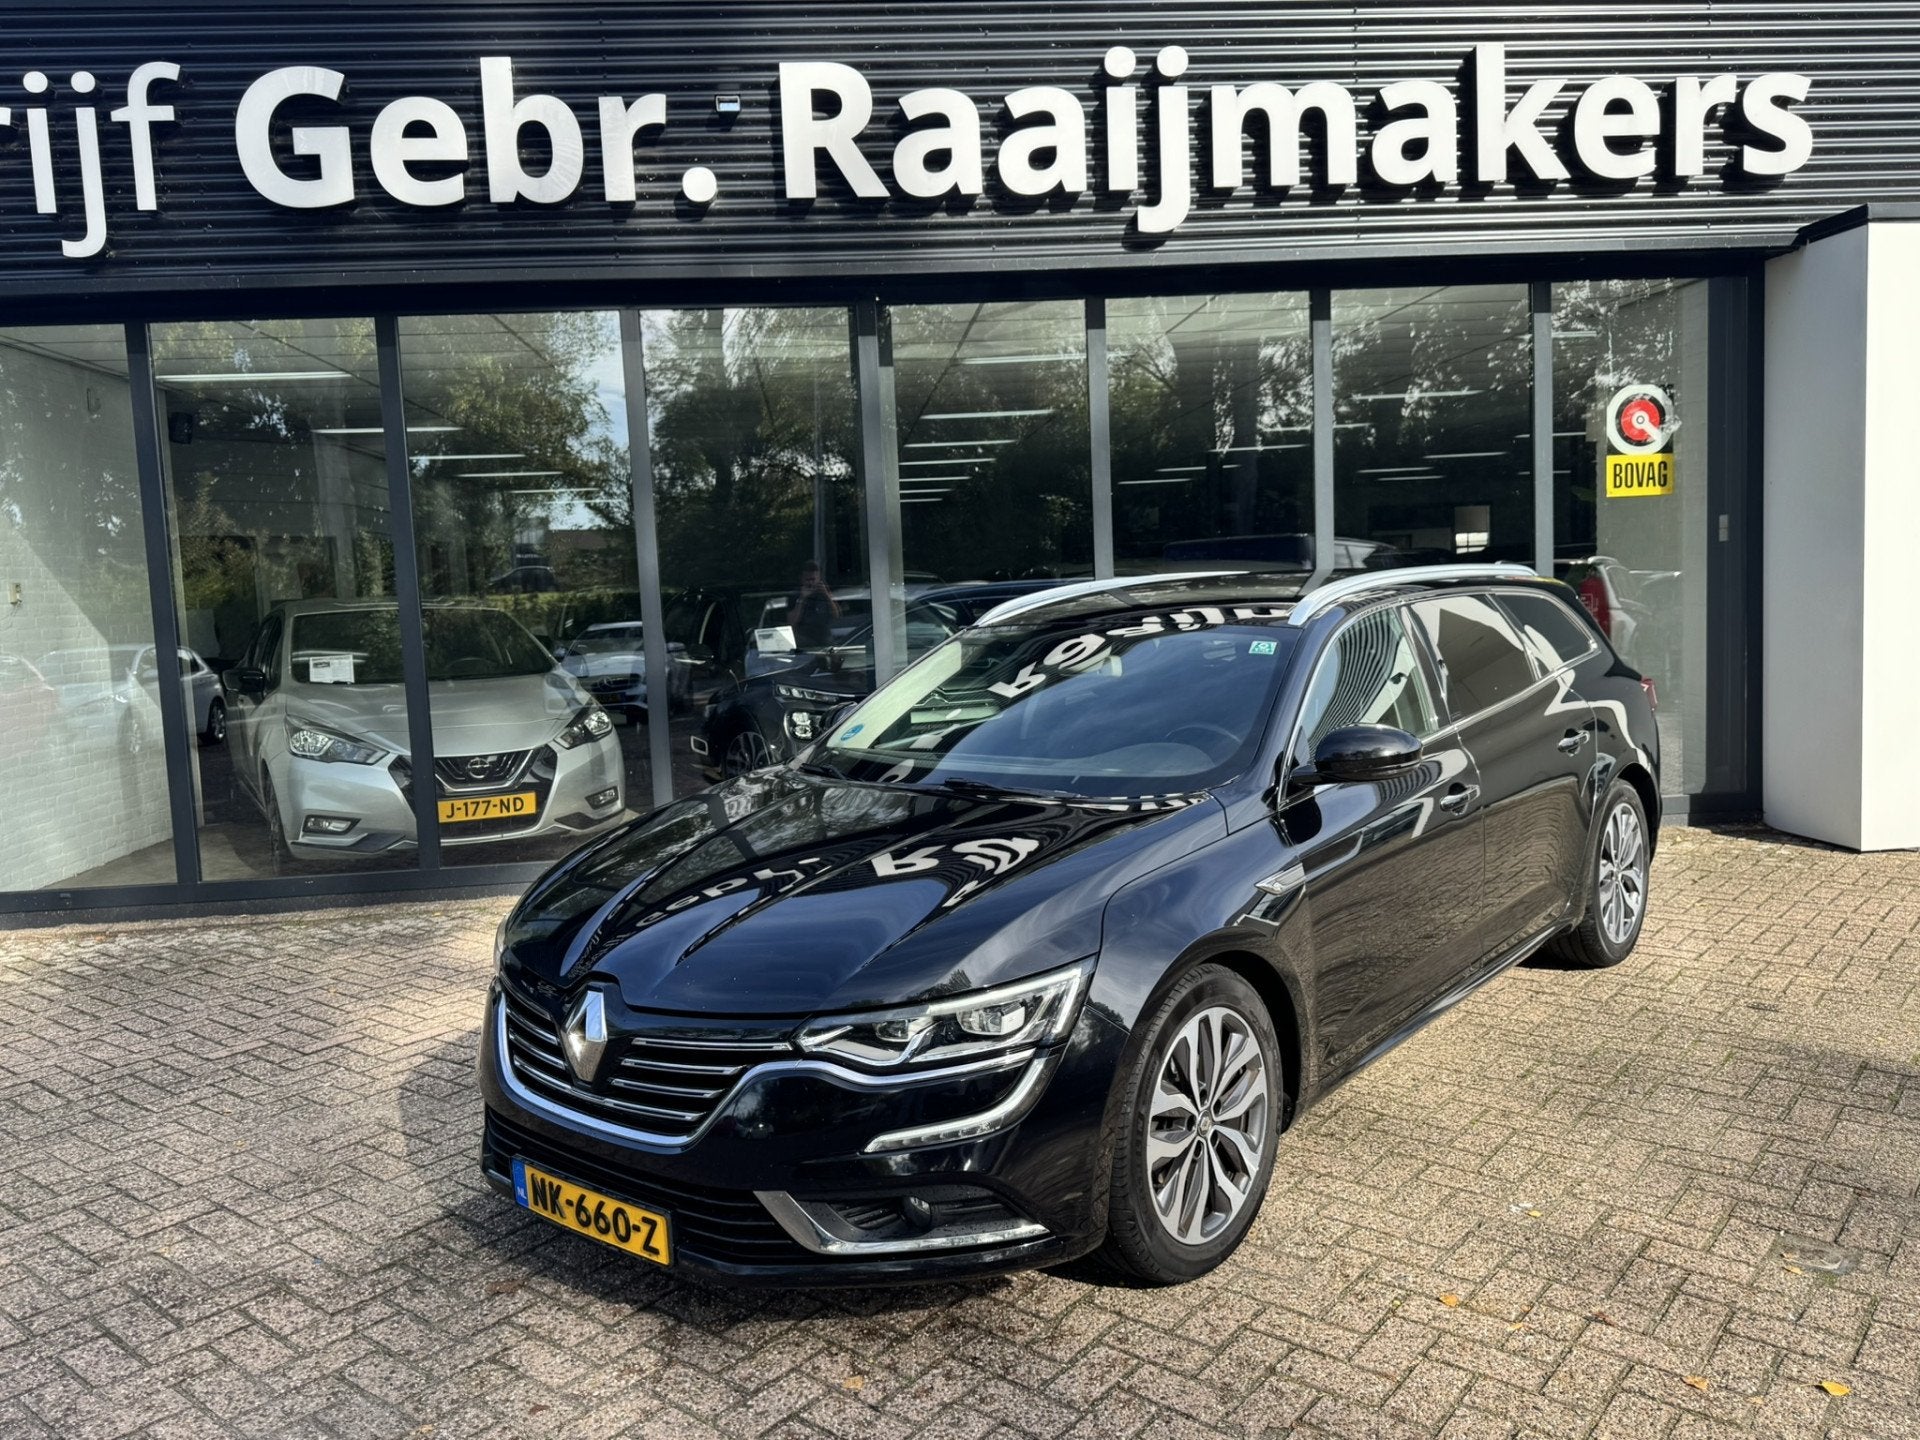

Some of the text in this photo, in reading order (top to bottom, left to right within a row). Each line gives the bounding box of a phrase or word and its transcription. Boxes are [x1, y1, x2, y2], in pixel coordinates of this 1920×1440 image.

[235, 56, 718, 208] Gebr.
[778, 43, 1813, 234] Raaijmakers
[1613, 461, 1668, 488] BOVAG
[446, 797, 524, 818] J-177-ND
[530, 1173, 660, 1255] NK-660-Z
